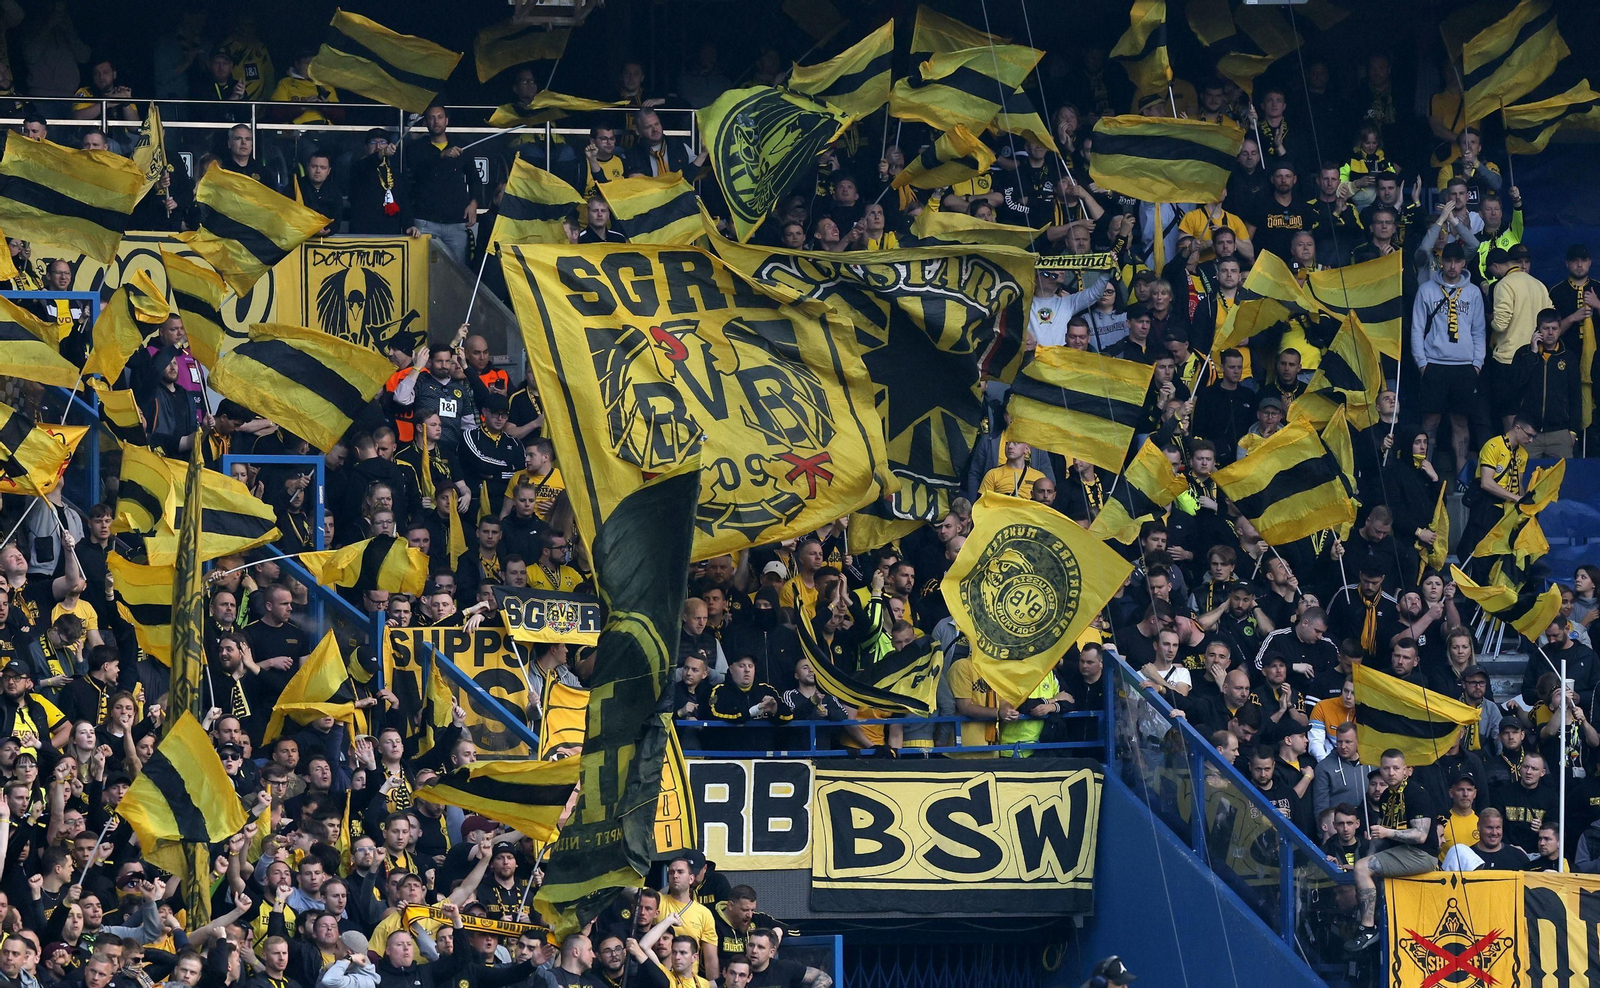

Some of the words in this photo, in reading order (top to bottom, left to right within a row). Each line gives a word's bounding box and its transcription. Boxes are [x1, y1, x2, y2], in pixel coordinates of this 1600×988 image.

[441, 401, 456, 412] 1&1
[717, 453, 769, 491] 09
[389, 629, 529, 669] SUPPS
[826, 777, 1089, 875] BSW
